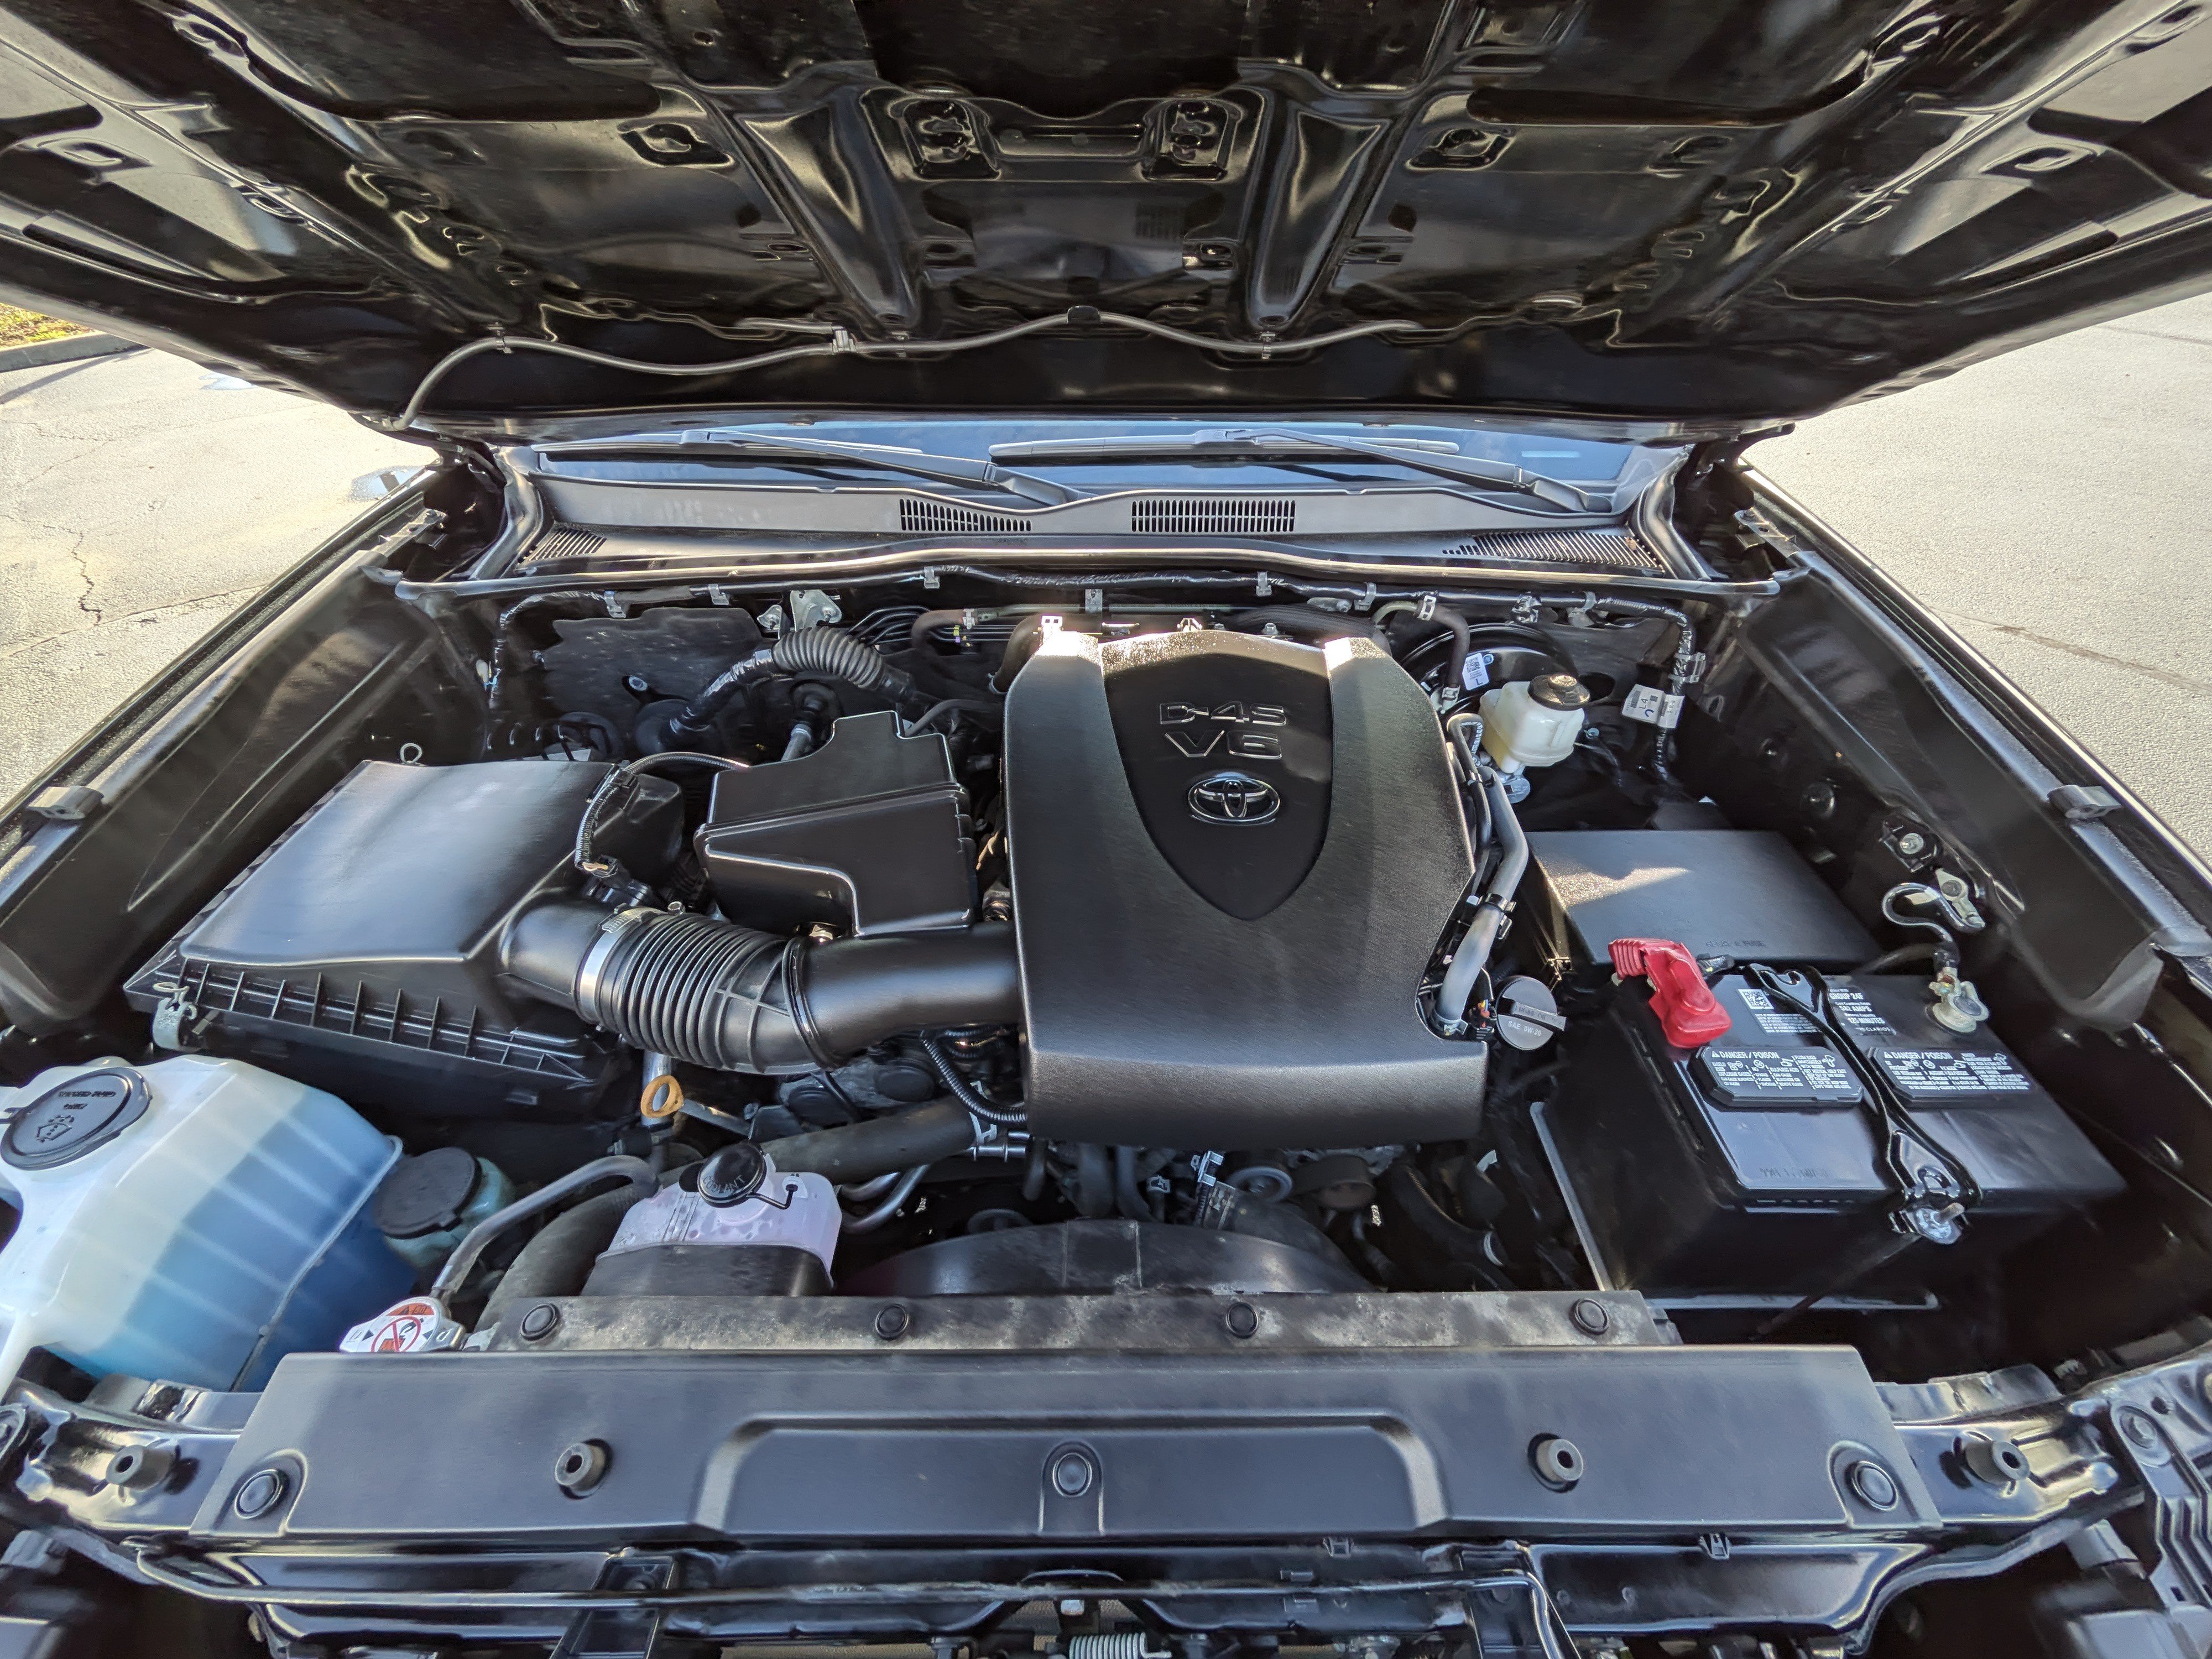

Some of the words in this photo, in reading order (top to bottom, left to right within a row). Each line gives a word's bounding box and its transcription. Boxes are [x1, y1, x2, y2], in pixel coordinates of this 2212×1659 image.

[1165, 730, 1282, 759] V6
[1507, 1020, 1521, 1030] SAE
[702, 1175, 745, 1194] COOLANT
